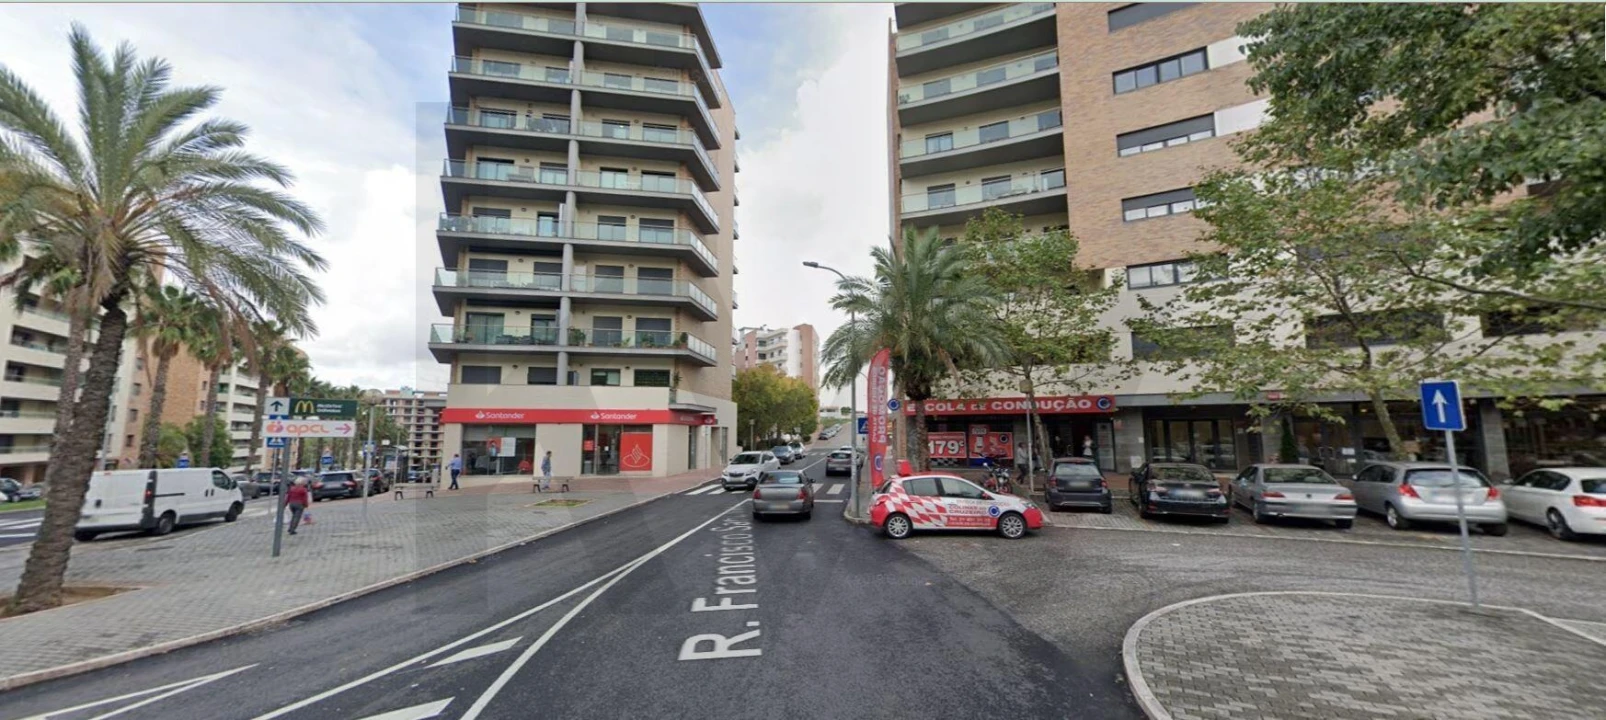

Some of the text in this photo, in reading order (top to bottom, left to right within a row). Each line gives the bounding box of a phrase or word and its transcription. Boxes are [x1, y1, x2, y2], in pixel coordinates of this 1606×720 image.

[906, 402, 966, 412] ECOLA
[485, 411, 525, 419] Santander
[600, 412, 637, 420] Santander
